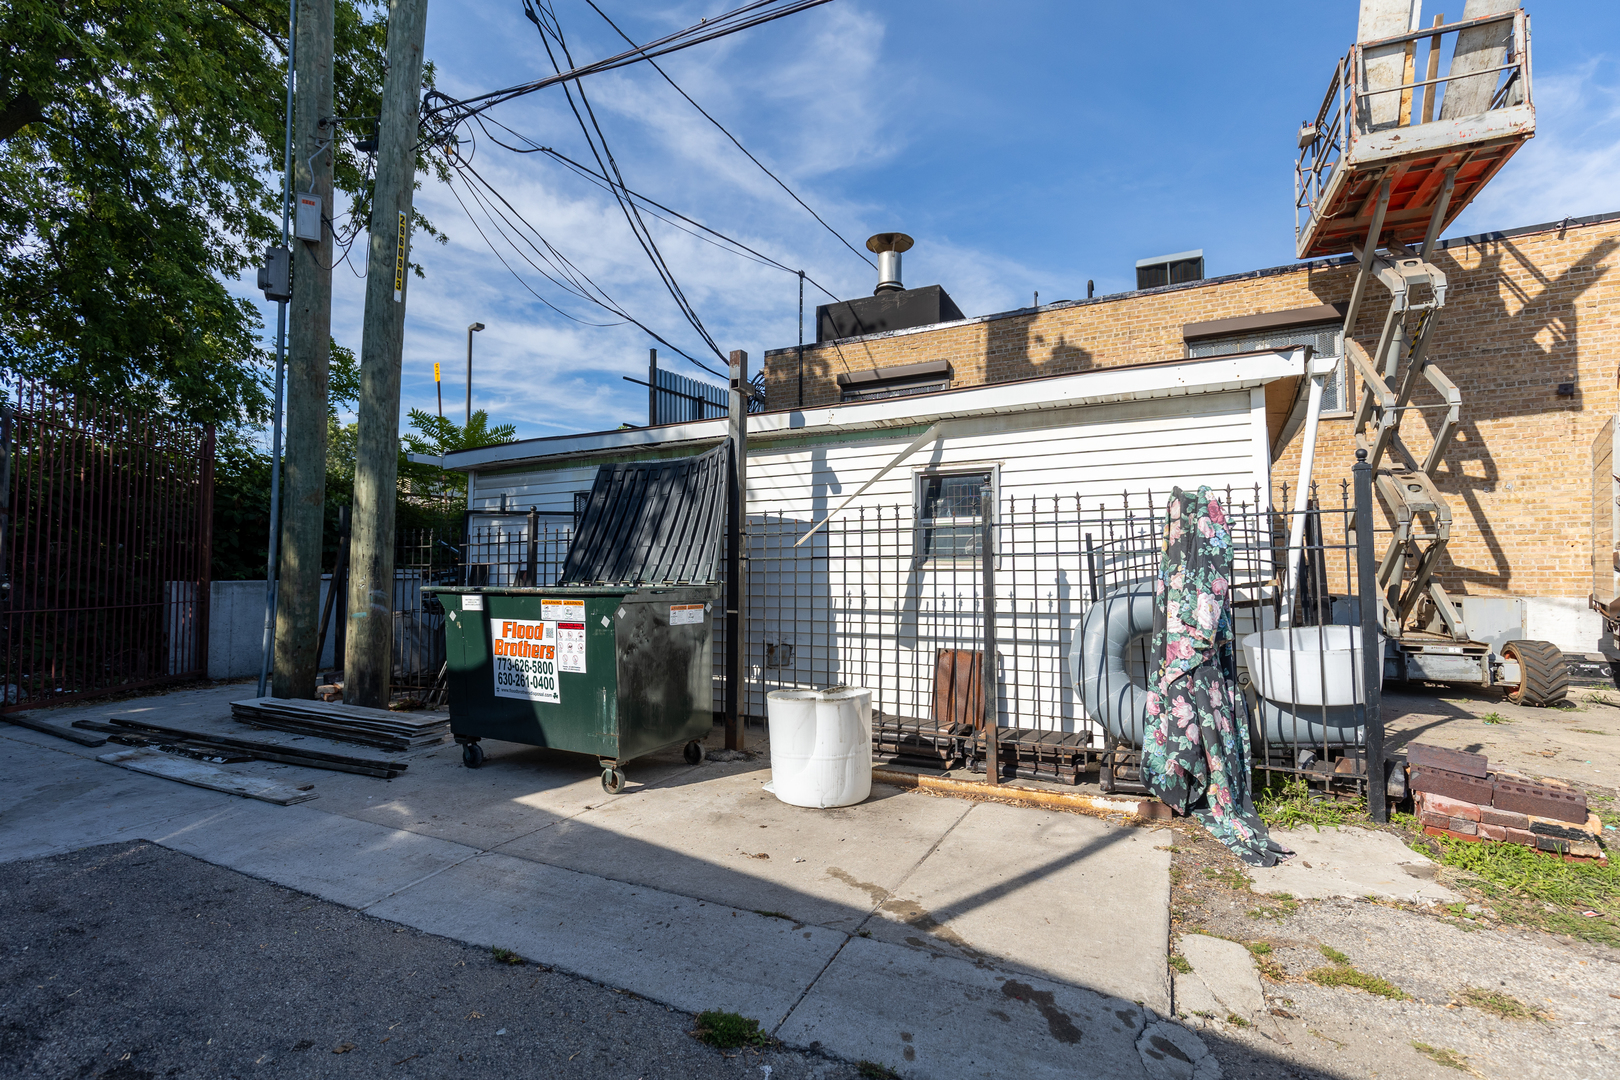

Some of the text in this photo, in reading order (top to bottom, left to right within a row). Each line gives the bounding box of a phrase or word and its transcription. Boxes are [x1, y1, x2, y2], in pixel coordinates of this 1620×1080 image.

[502, 621, 544, 640] Flood
[494, 639, 555, 659] Brothers
[497, 657, 553, 675] 773-626-5800
[497, 672, 554, 691] 630-261-0400
